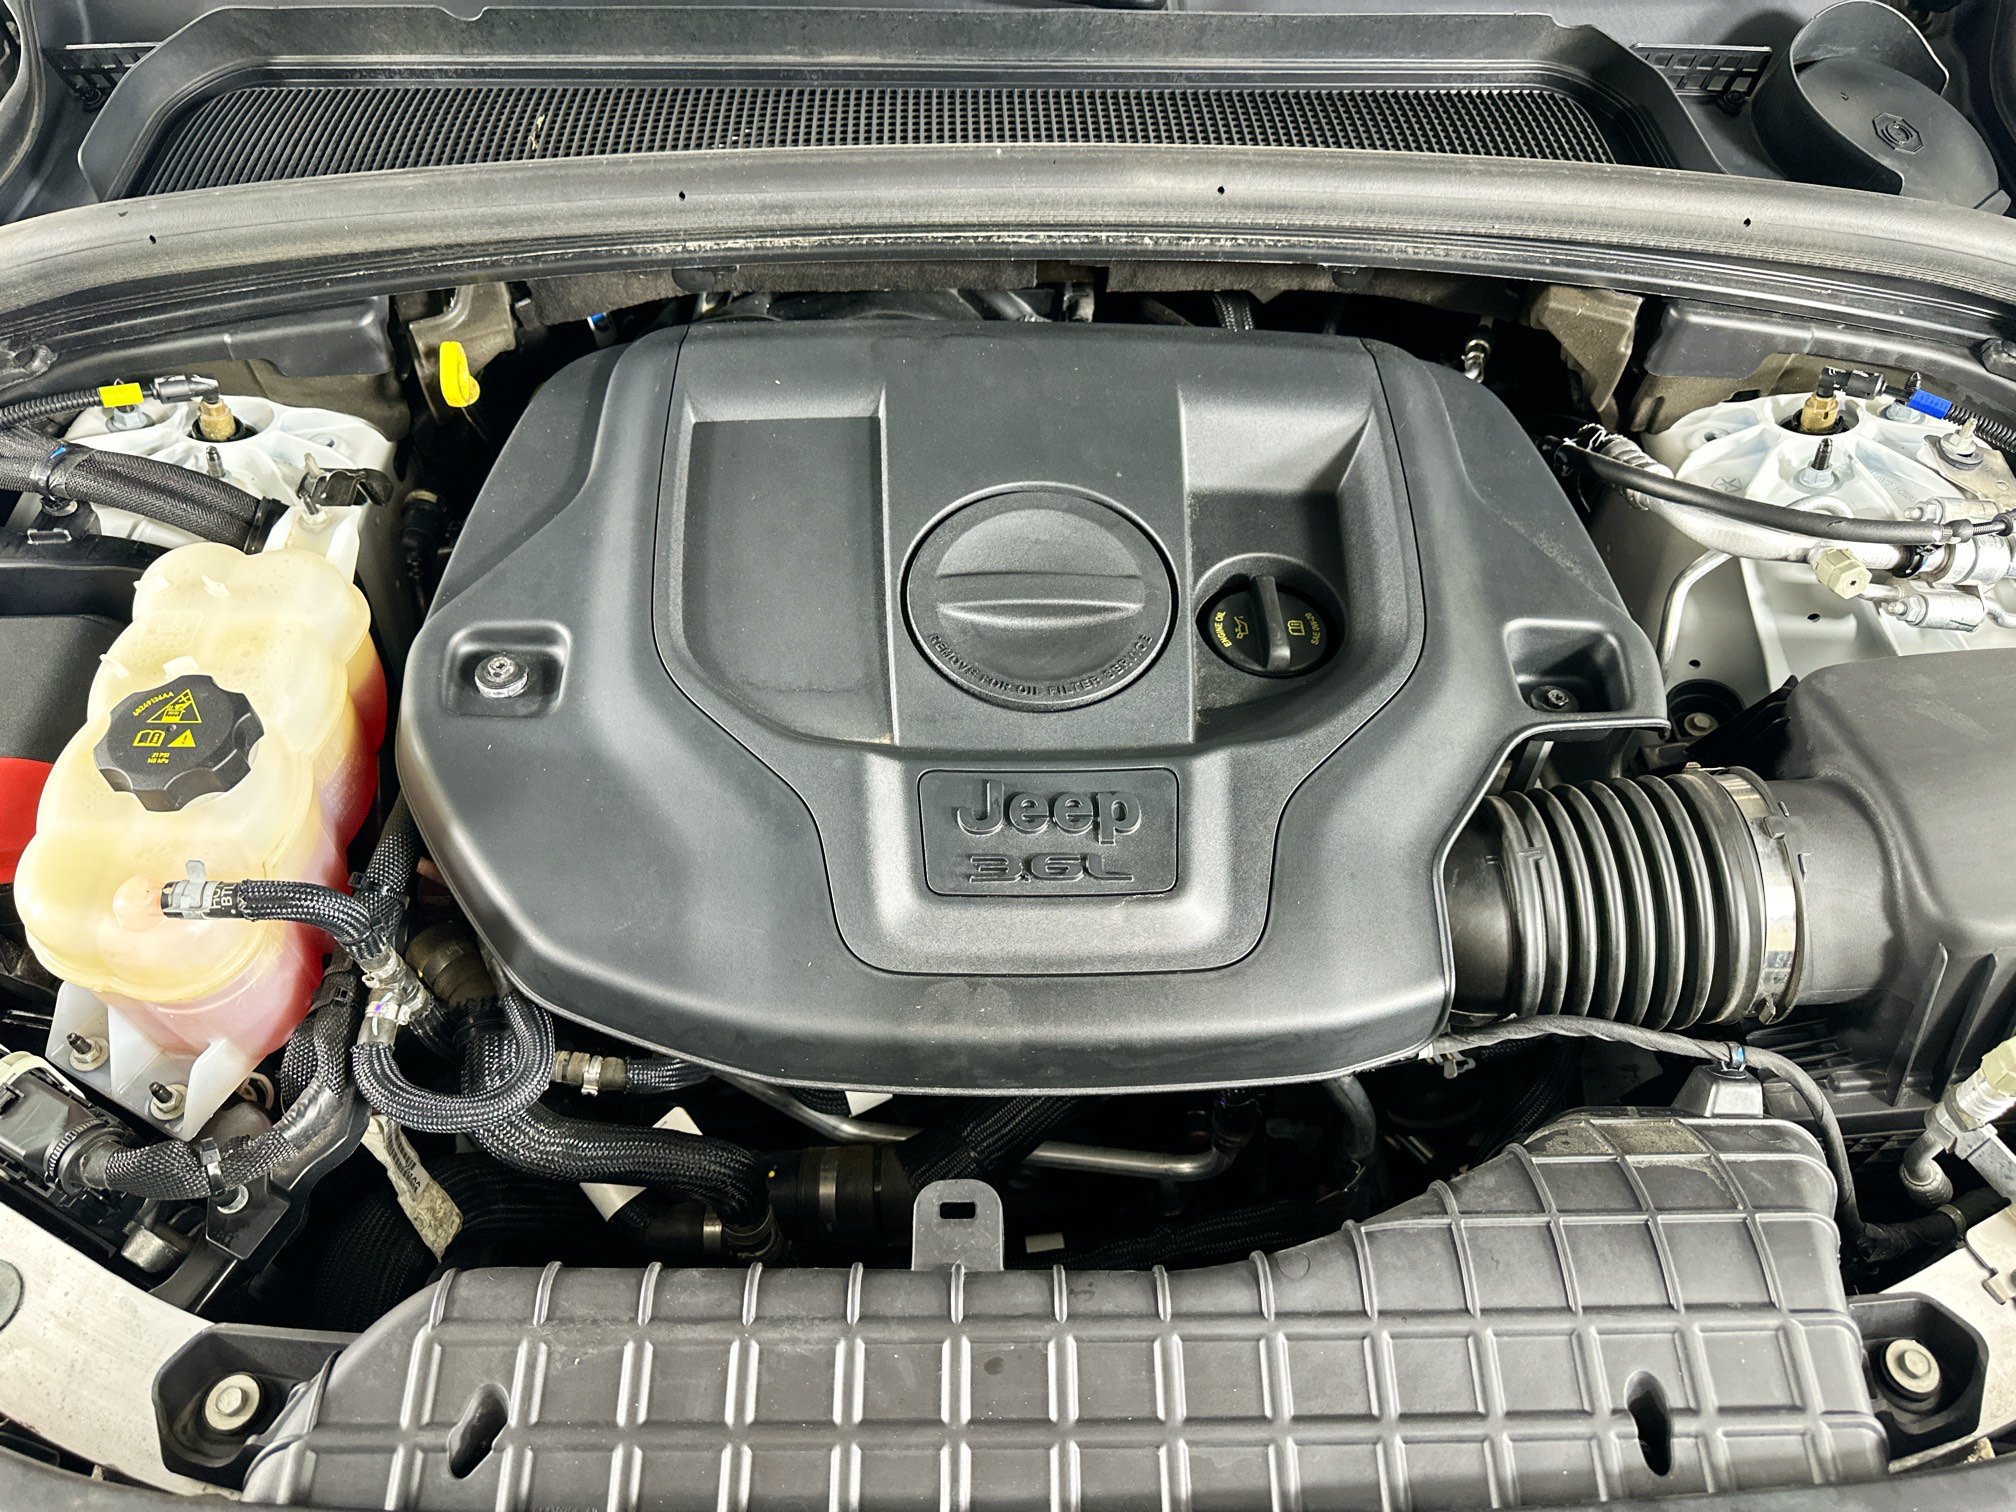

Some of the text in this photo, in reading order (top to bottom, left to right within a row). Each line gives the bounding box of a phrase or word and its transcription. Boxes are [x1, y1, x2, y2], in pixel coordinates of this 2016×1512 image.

[1215, 611, 1232, 648] ENGINE OIL
[1310, 632, 1321, 646] SAE
[928, 632, 1154, 696] REMOVE FOR OIL FILTER SERVICE
[956, 780, 1142, 845] Jeep
[967, 852, 1135, 883] 3.6L
